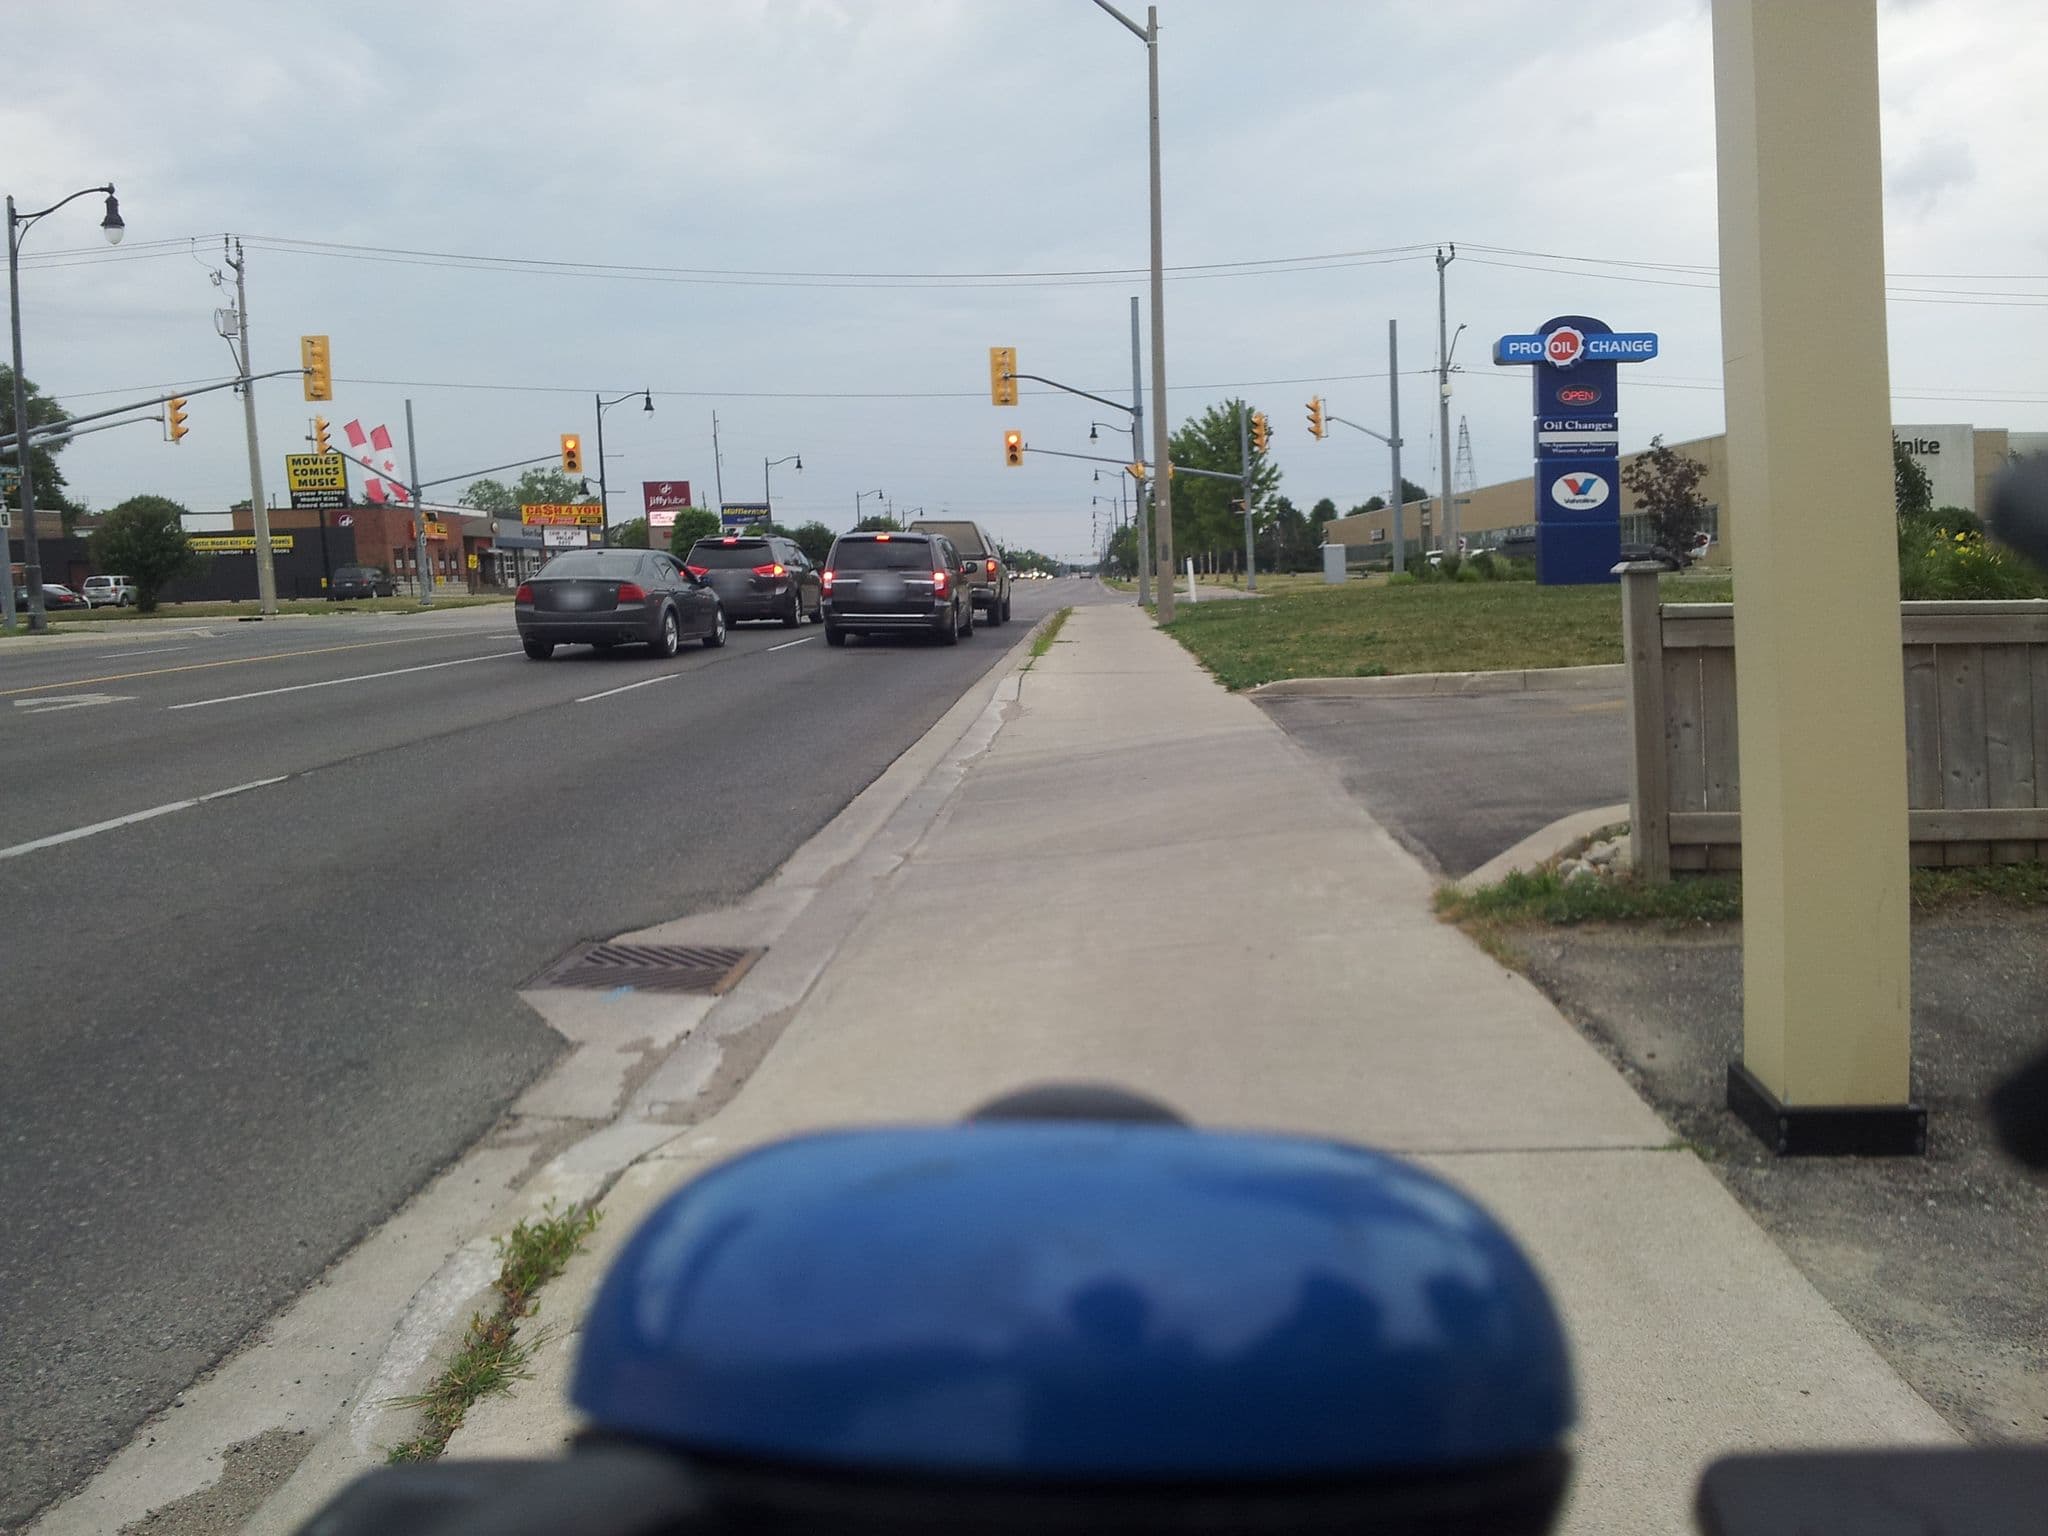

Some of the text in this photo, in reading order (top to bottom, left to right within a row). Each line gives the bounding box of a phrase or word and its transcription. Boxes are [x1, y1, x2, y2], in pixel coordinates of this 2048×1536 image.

[1509, 340, 1653, 354] PRO OIL CHANGE
[1561, 391, 1594, 401] OPEN
[1543, 420, 1613, 430] Oil Changes
[291, 456, 338, 466] MOVIES
[293, 467, 339, 476] COMICS
[297, 478, 337, 487] MUSIC
[565, 506, 574, 515] 4
[576, 505, 601, 515] YOU
